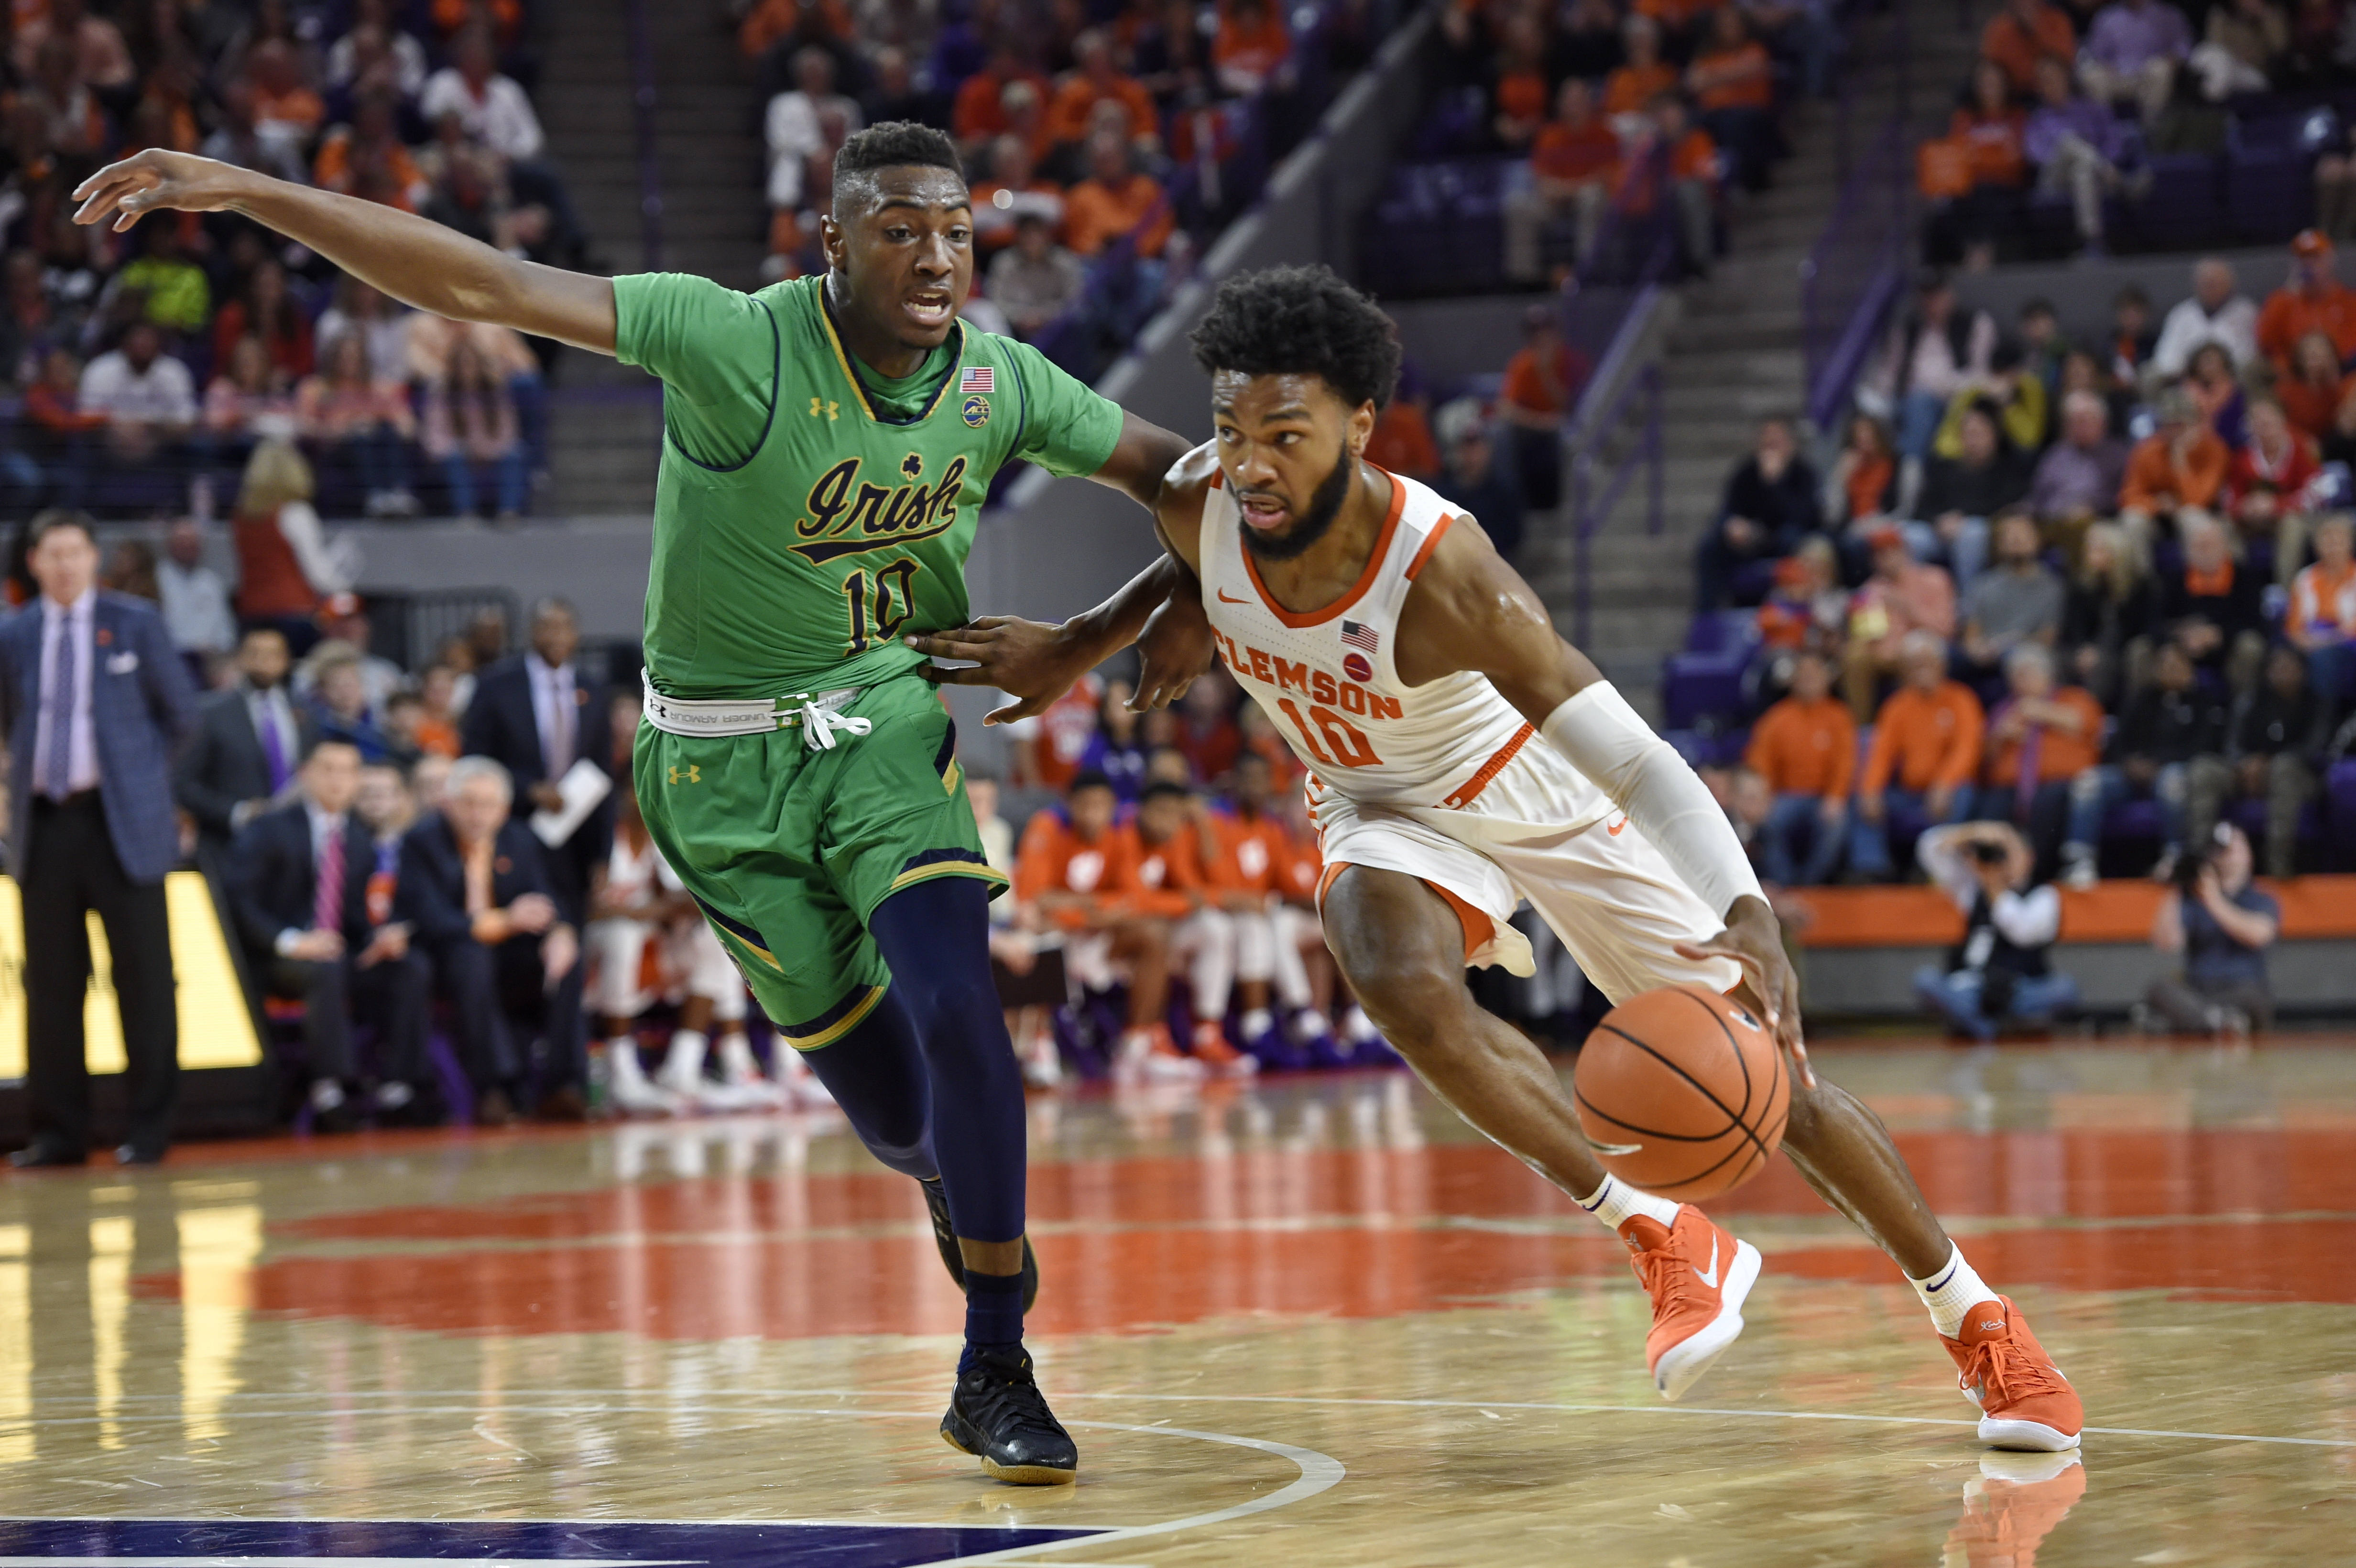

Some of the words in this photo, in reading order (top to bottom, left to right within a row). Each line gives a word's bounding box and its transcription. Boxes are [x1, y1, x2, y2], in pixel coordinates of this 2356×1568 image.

[965, 405, 990, 414] ACC
[794, 454, 968, 541] Irish
[841, 556, 921, 657] 10
[1211, 624, 1404, 720] CLEMSON
[670, 711, 717, 724] ARMOUR
[722, 712, 765, 723] UNDER
[1277, 697, 1384, 768] 10
